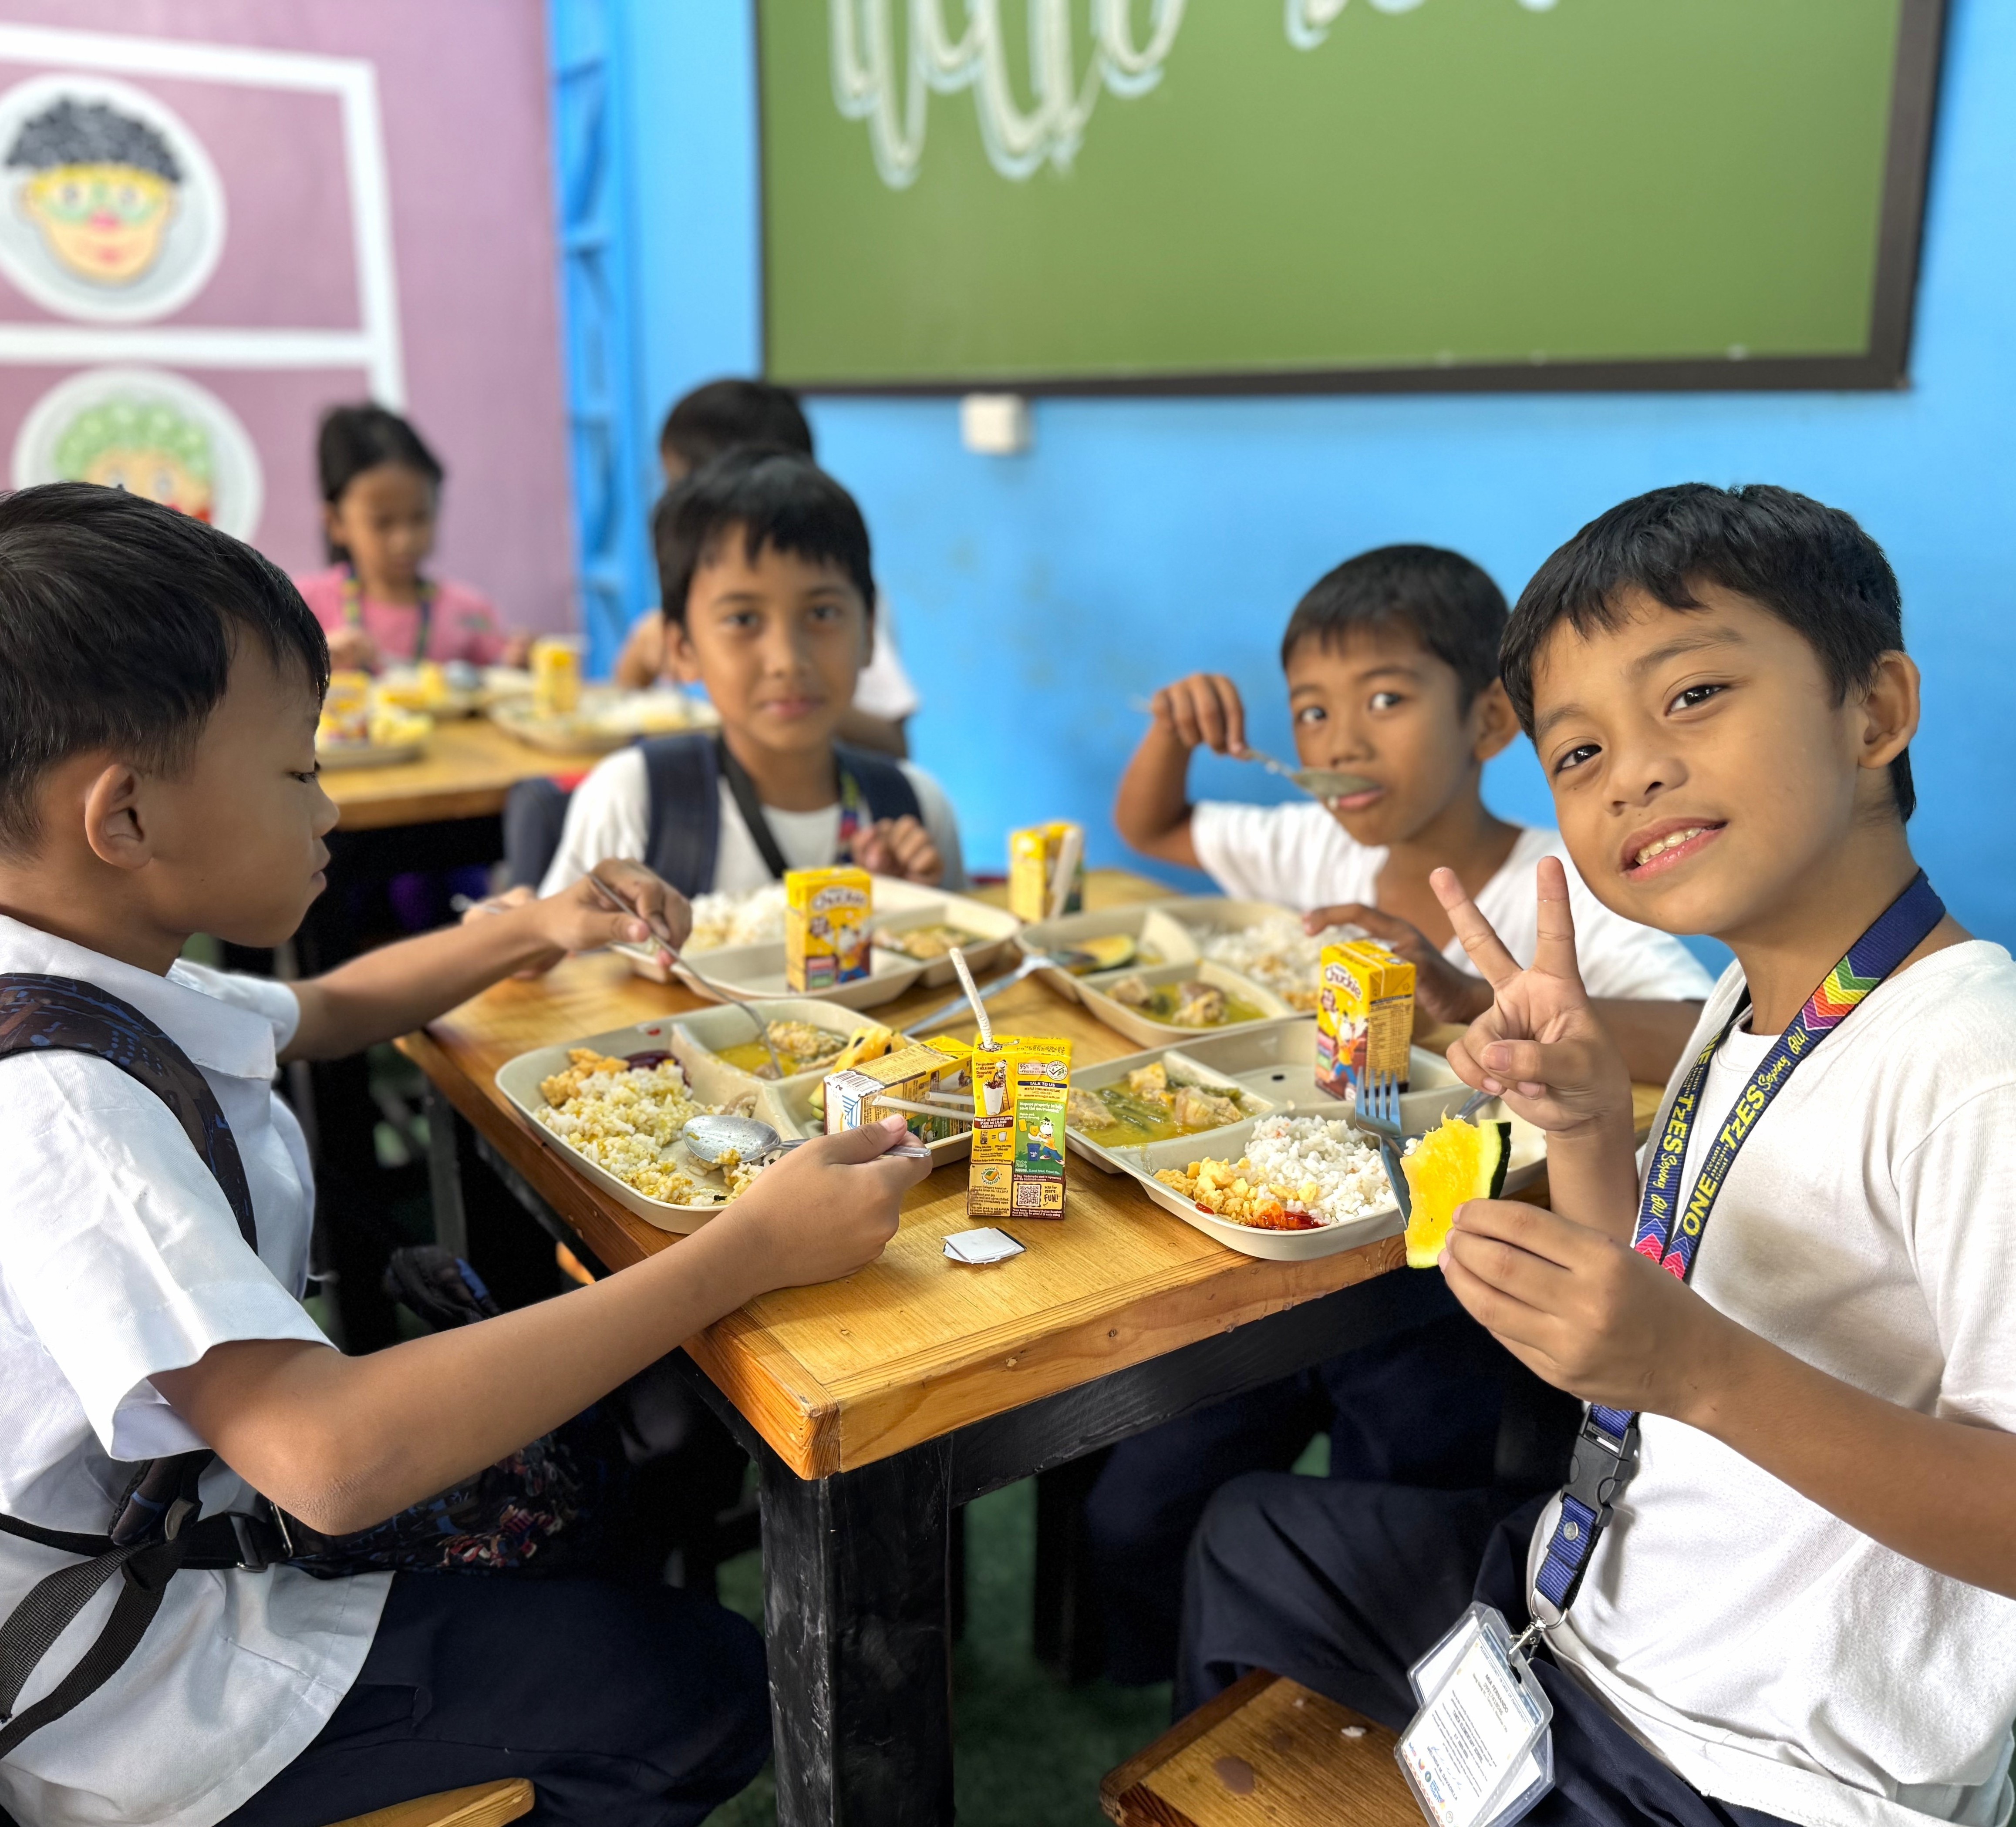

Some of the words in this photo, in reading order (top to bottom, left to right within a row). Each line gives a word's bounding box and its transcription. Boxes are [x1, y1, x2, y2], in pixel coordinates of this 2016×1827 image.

[1693, 1029, 1723, 1067] NE
[1683, 1173, 1717, 1235] ONE
[1720, 1085, 1764, 1149] TzES
[1044, 1194, 1059, 1203] FUN!
[1491, 1684, 1508, 1713] FERNANDO
